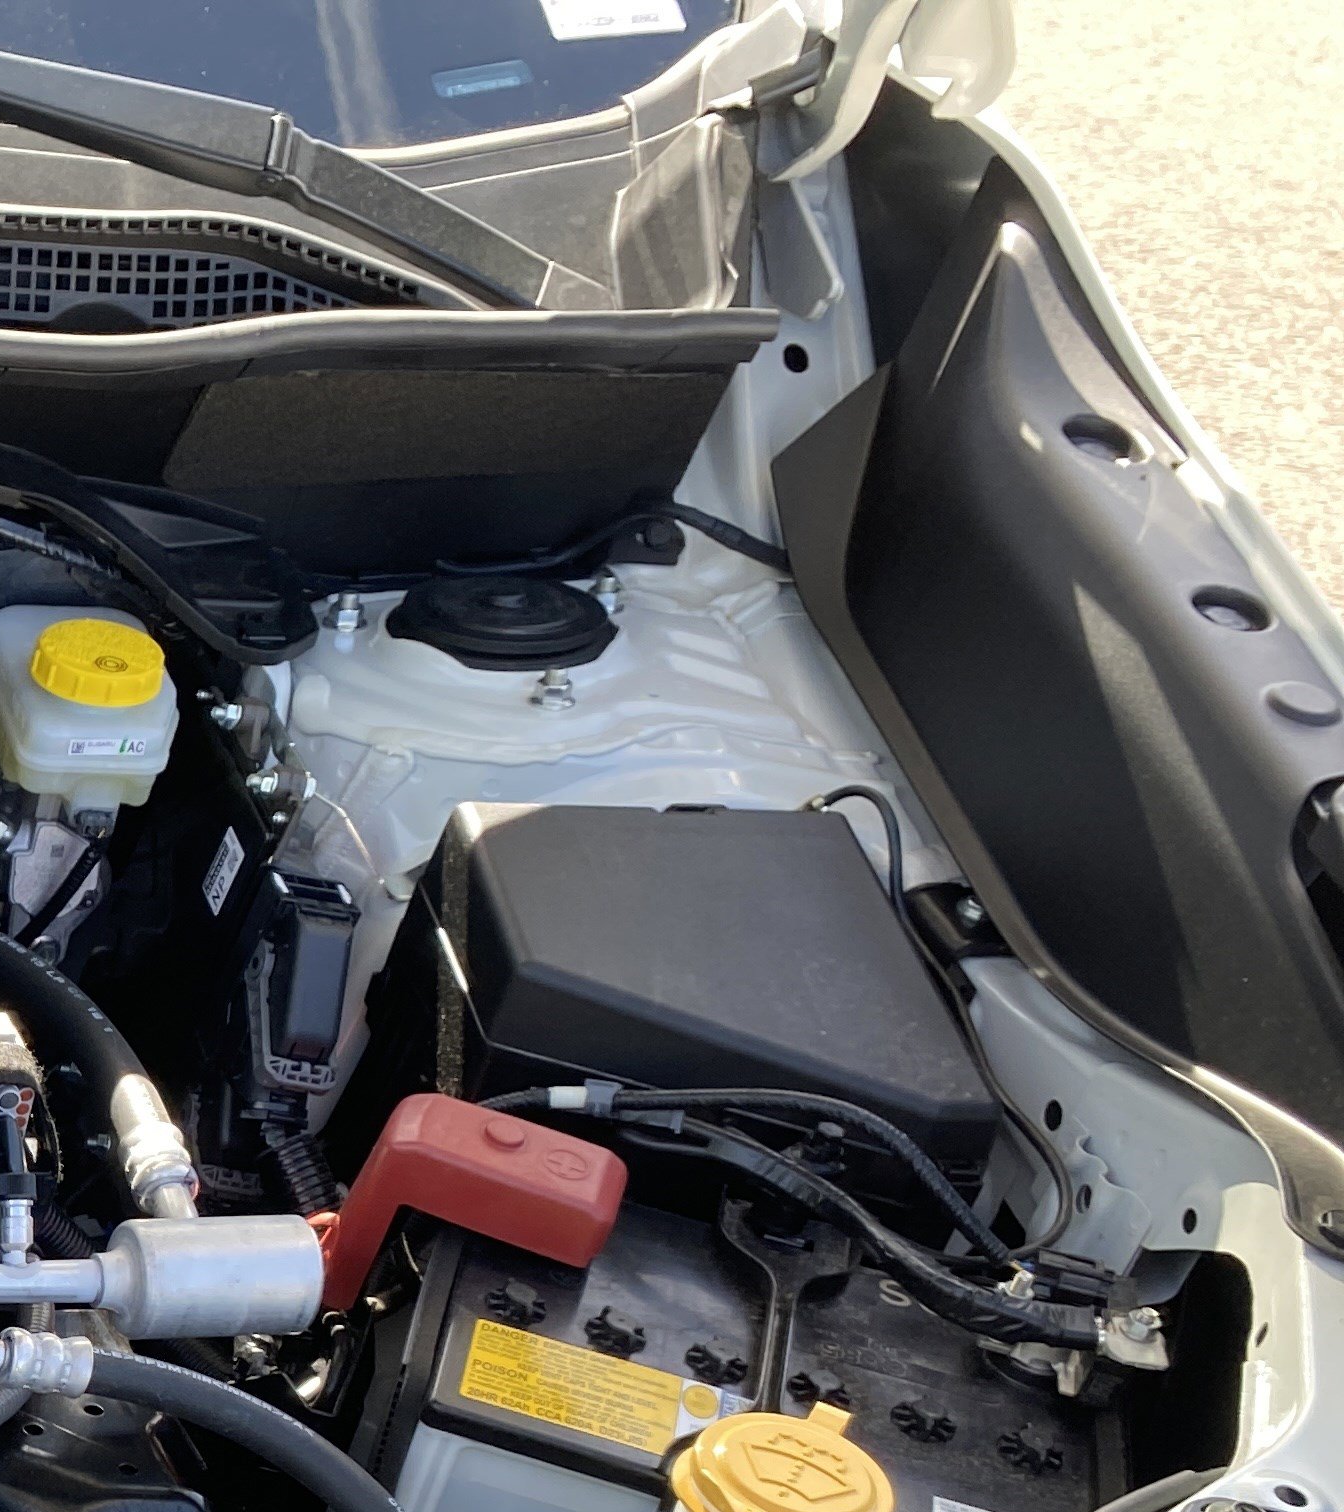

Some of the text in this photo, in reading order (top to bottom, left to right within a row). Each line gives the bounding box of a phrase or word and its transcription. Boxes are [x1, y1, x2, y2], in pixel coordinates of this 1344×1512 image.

[127, 740, 145, 753] AC
[481, 1323, 538, 1345] DANGER
[472, 1358, 528, 1381] POISON
[536, 1407, 563, 1422] CCA
